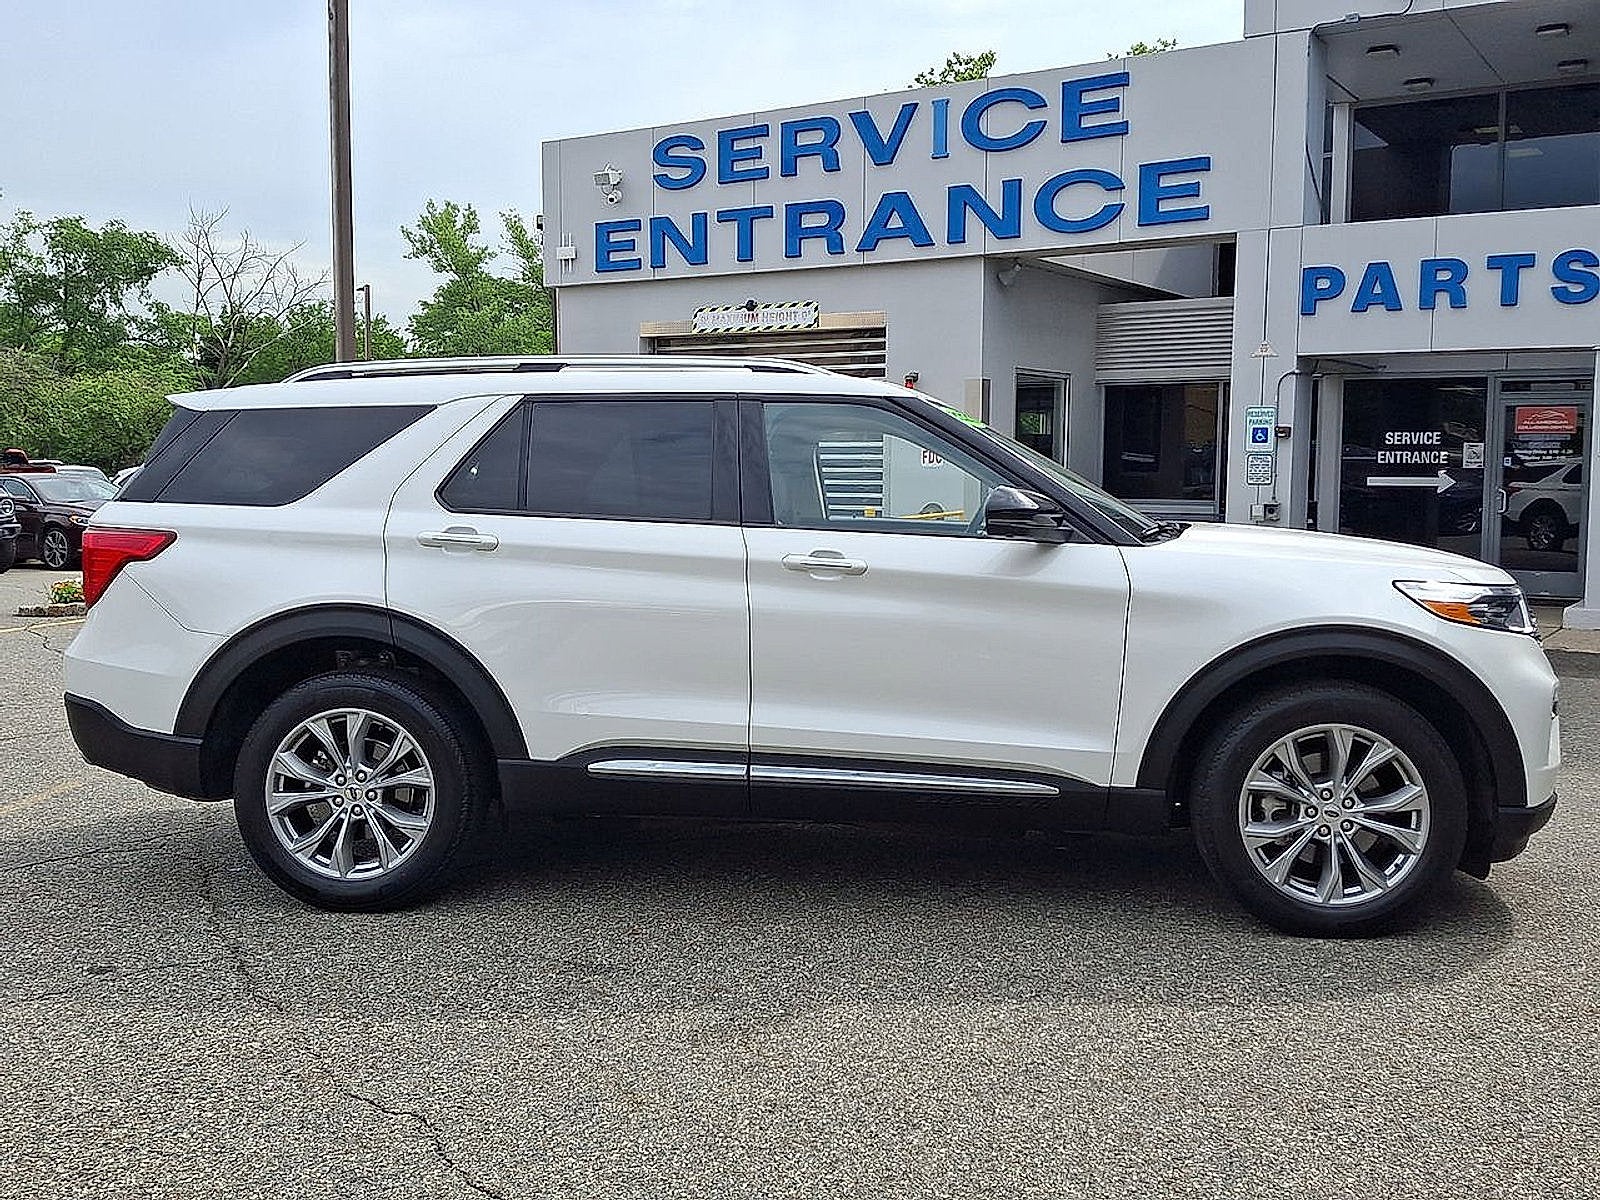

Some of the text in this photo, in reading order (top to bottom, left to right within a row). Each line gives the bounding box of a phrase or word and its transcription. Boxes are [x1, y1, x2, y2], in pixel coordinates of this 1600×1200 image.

[652, 71, 1131, 190] SERVICE
[594, 156, 1212, 272] ENTRANCE
[1300, 249, 1600, 315] PARTS
[1377, 450, 1449, 464] ENTRANCE
[1384, 431, 1442, 445] SERVICE
